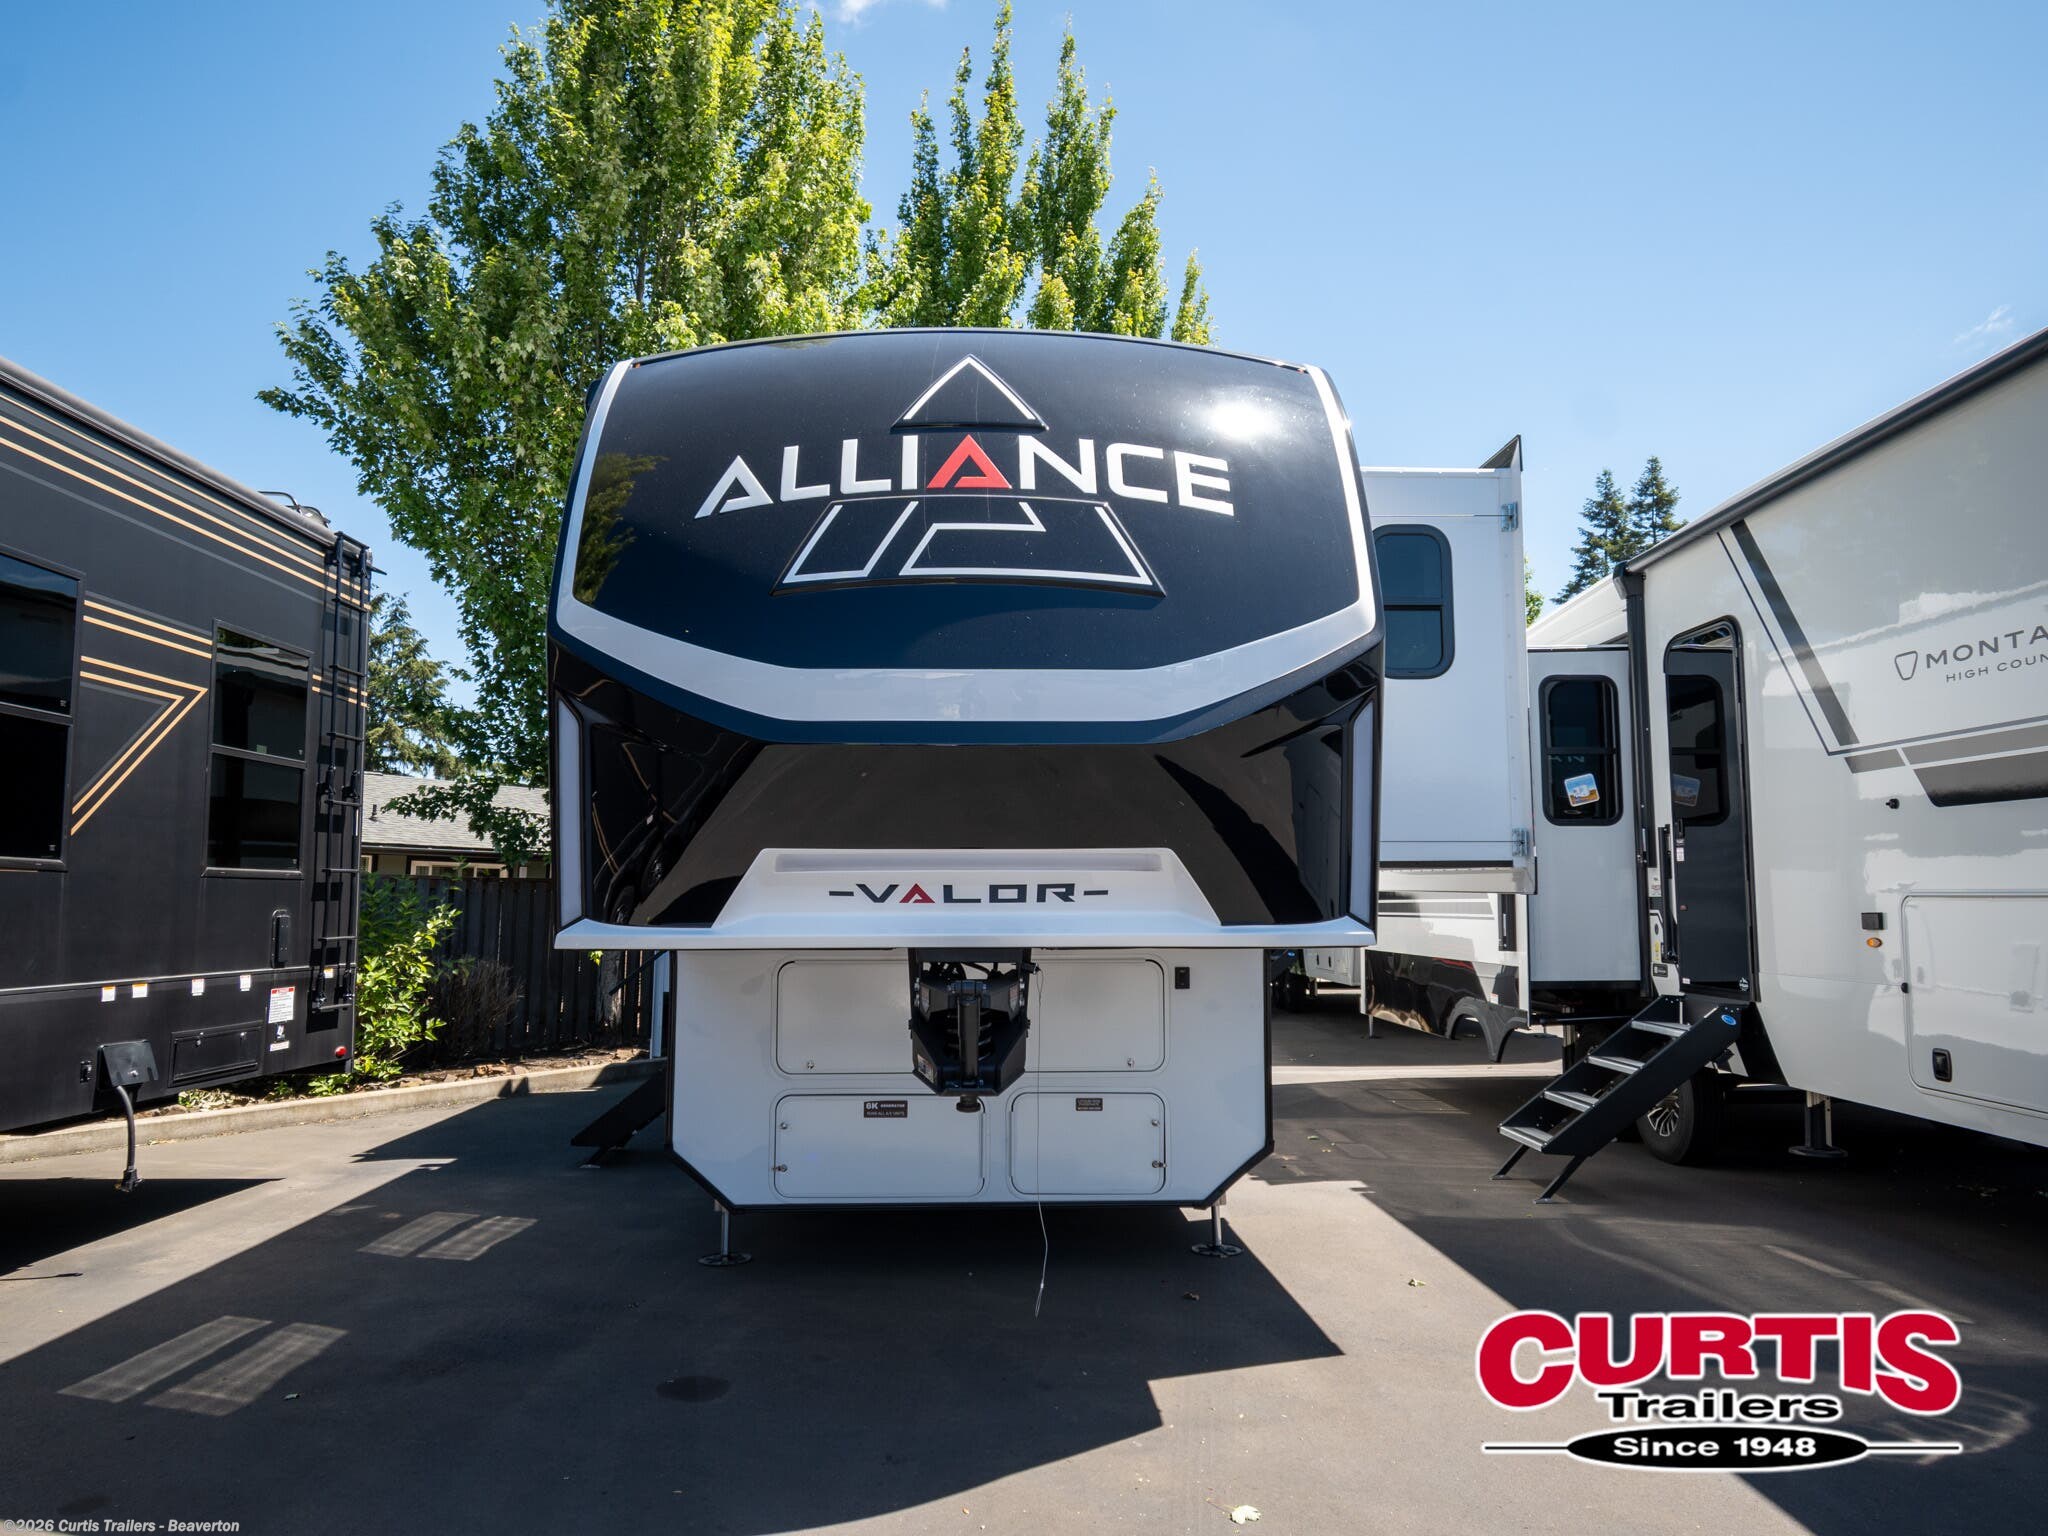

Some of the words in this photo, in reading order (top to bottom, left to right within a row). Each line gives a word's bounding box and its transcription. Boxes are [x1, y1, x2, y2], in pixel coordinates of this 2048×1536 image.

[695, 434, 1235, 519] ALLIANCE
[1926, 625, 2048, 669] MONTA
[1946, 666, 1989, 682] HIGH
